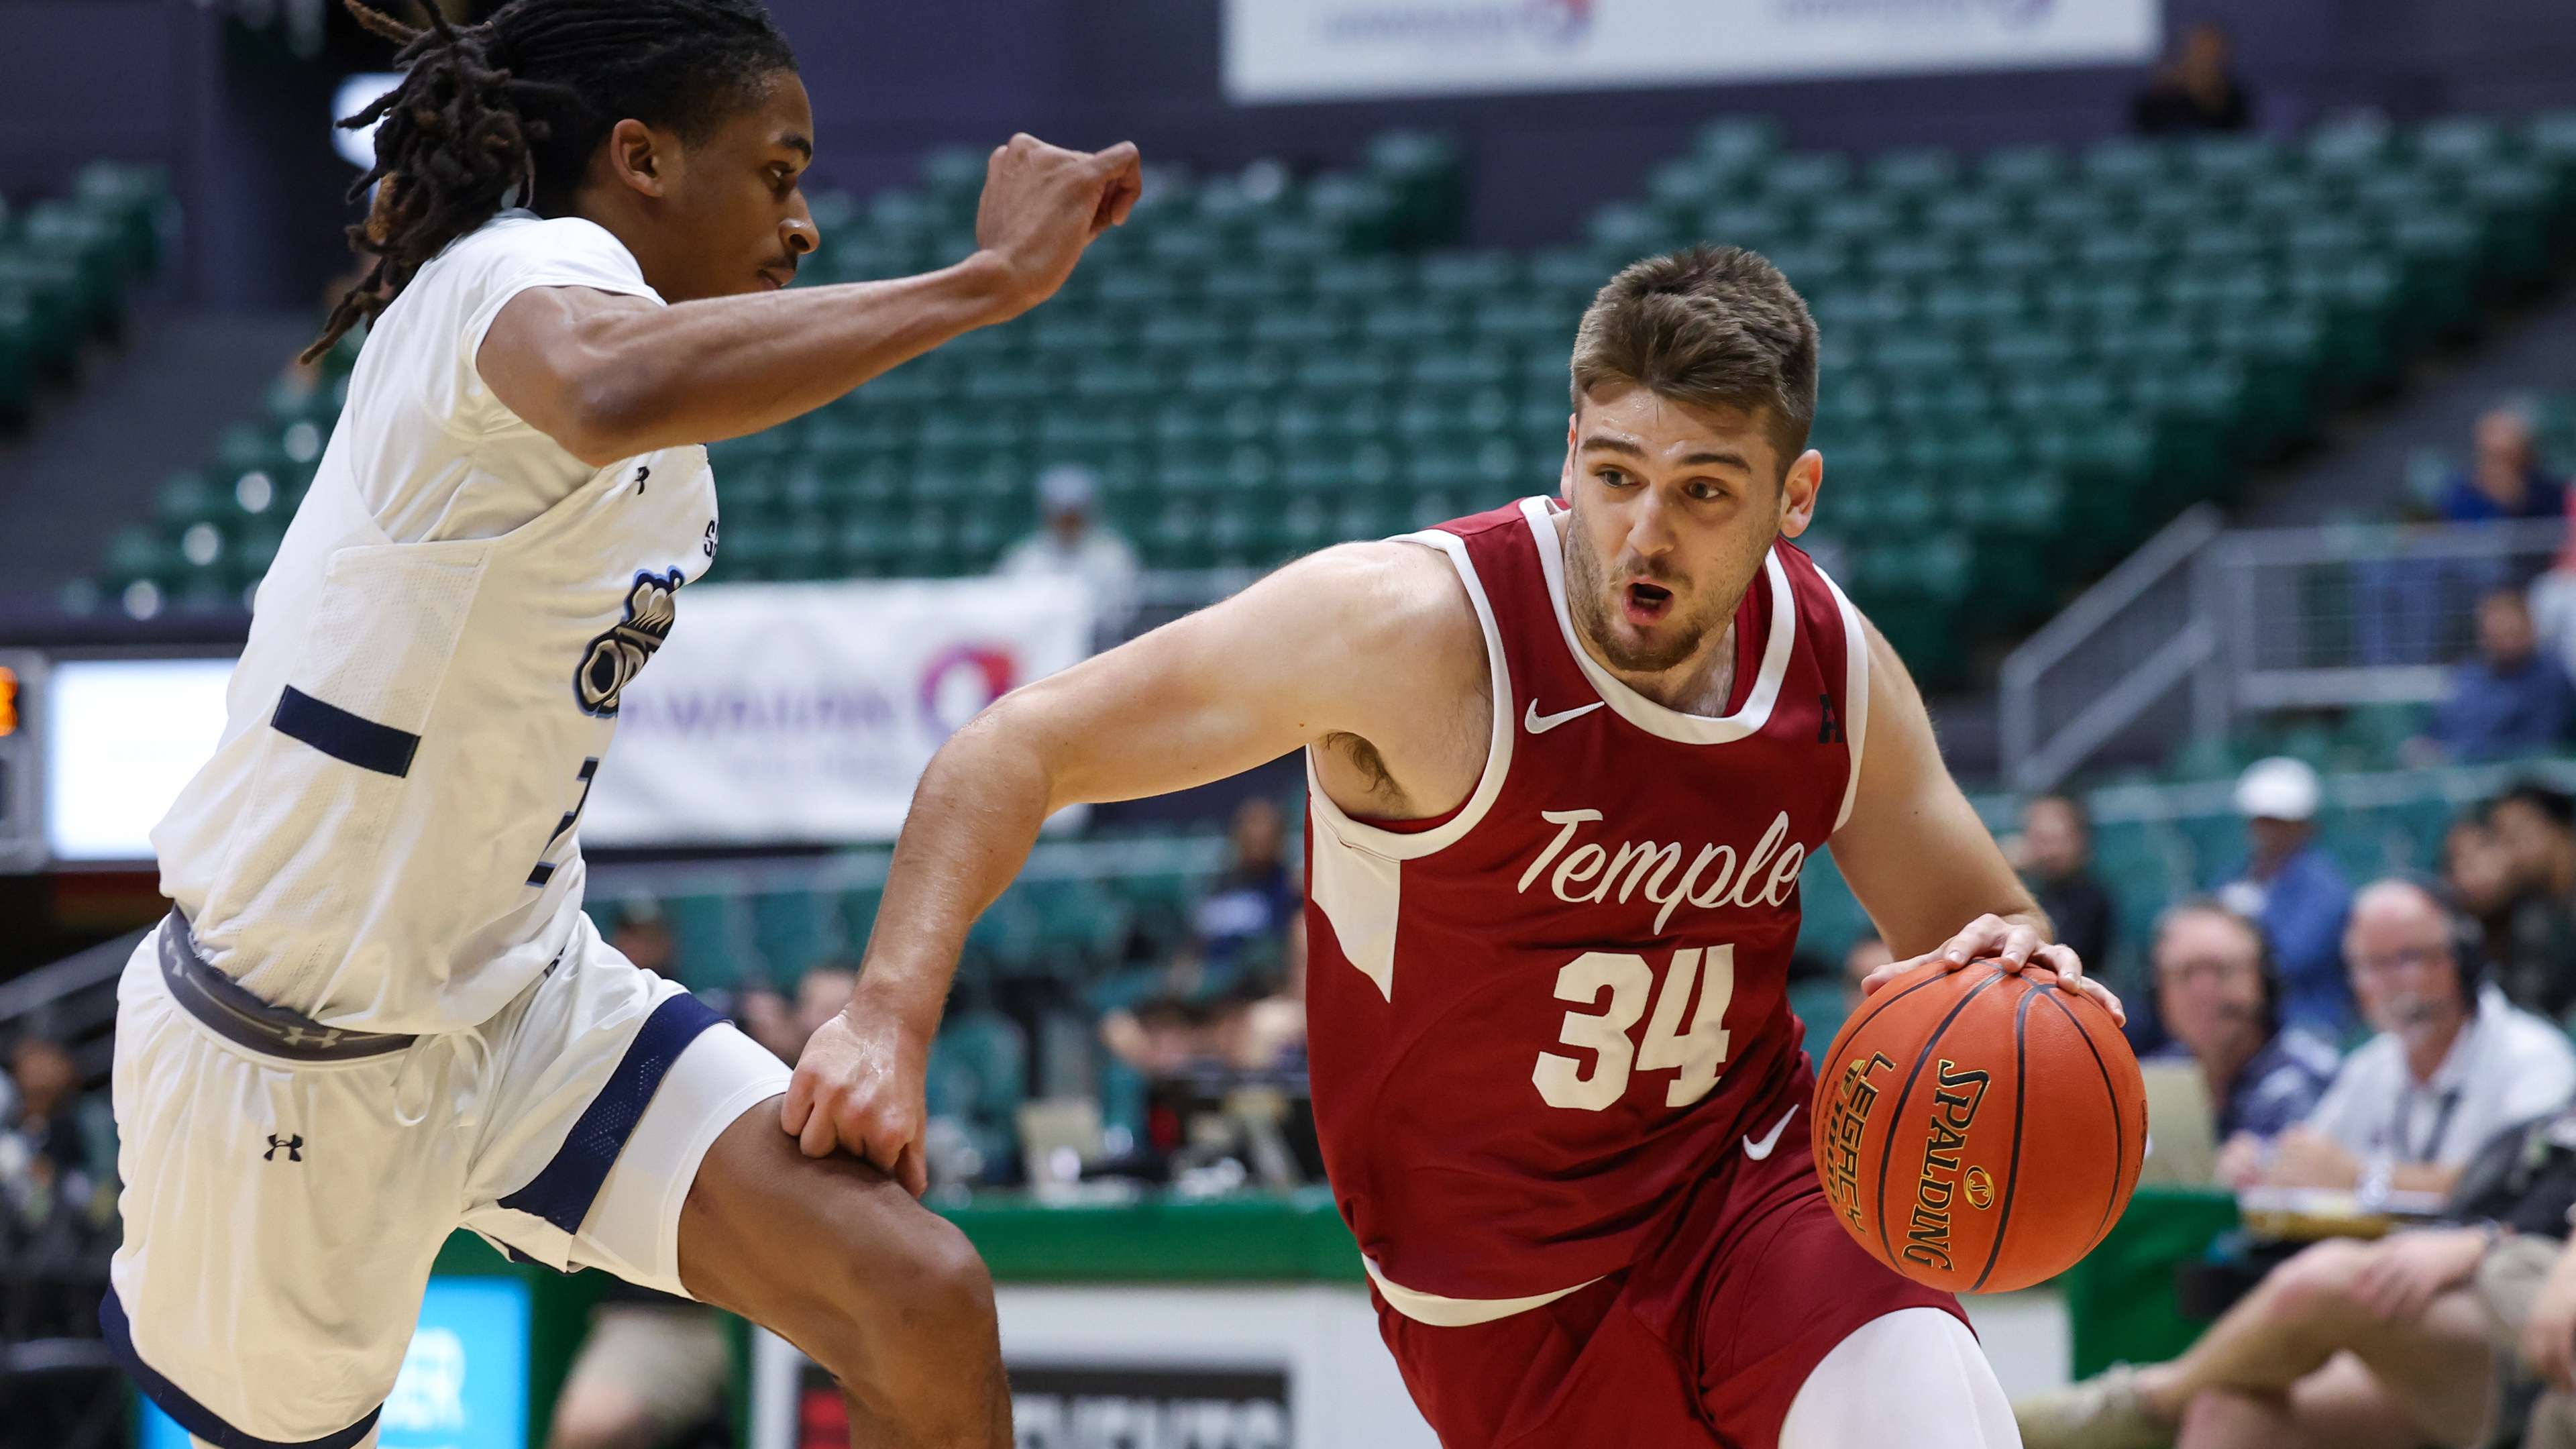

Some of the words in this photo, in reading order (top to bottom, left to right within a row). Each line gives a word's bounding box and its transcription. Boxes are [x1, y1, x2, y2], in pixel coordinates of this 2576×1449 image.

[1518, 808, 1805, 935] Temple
[1532, 943, 1735, 1111] 34
[1837, 1051, 1896, 1236] LEGACY
[1901, 1059, 1990, 1271] SPALDING
